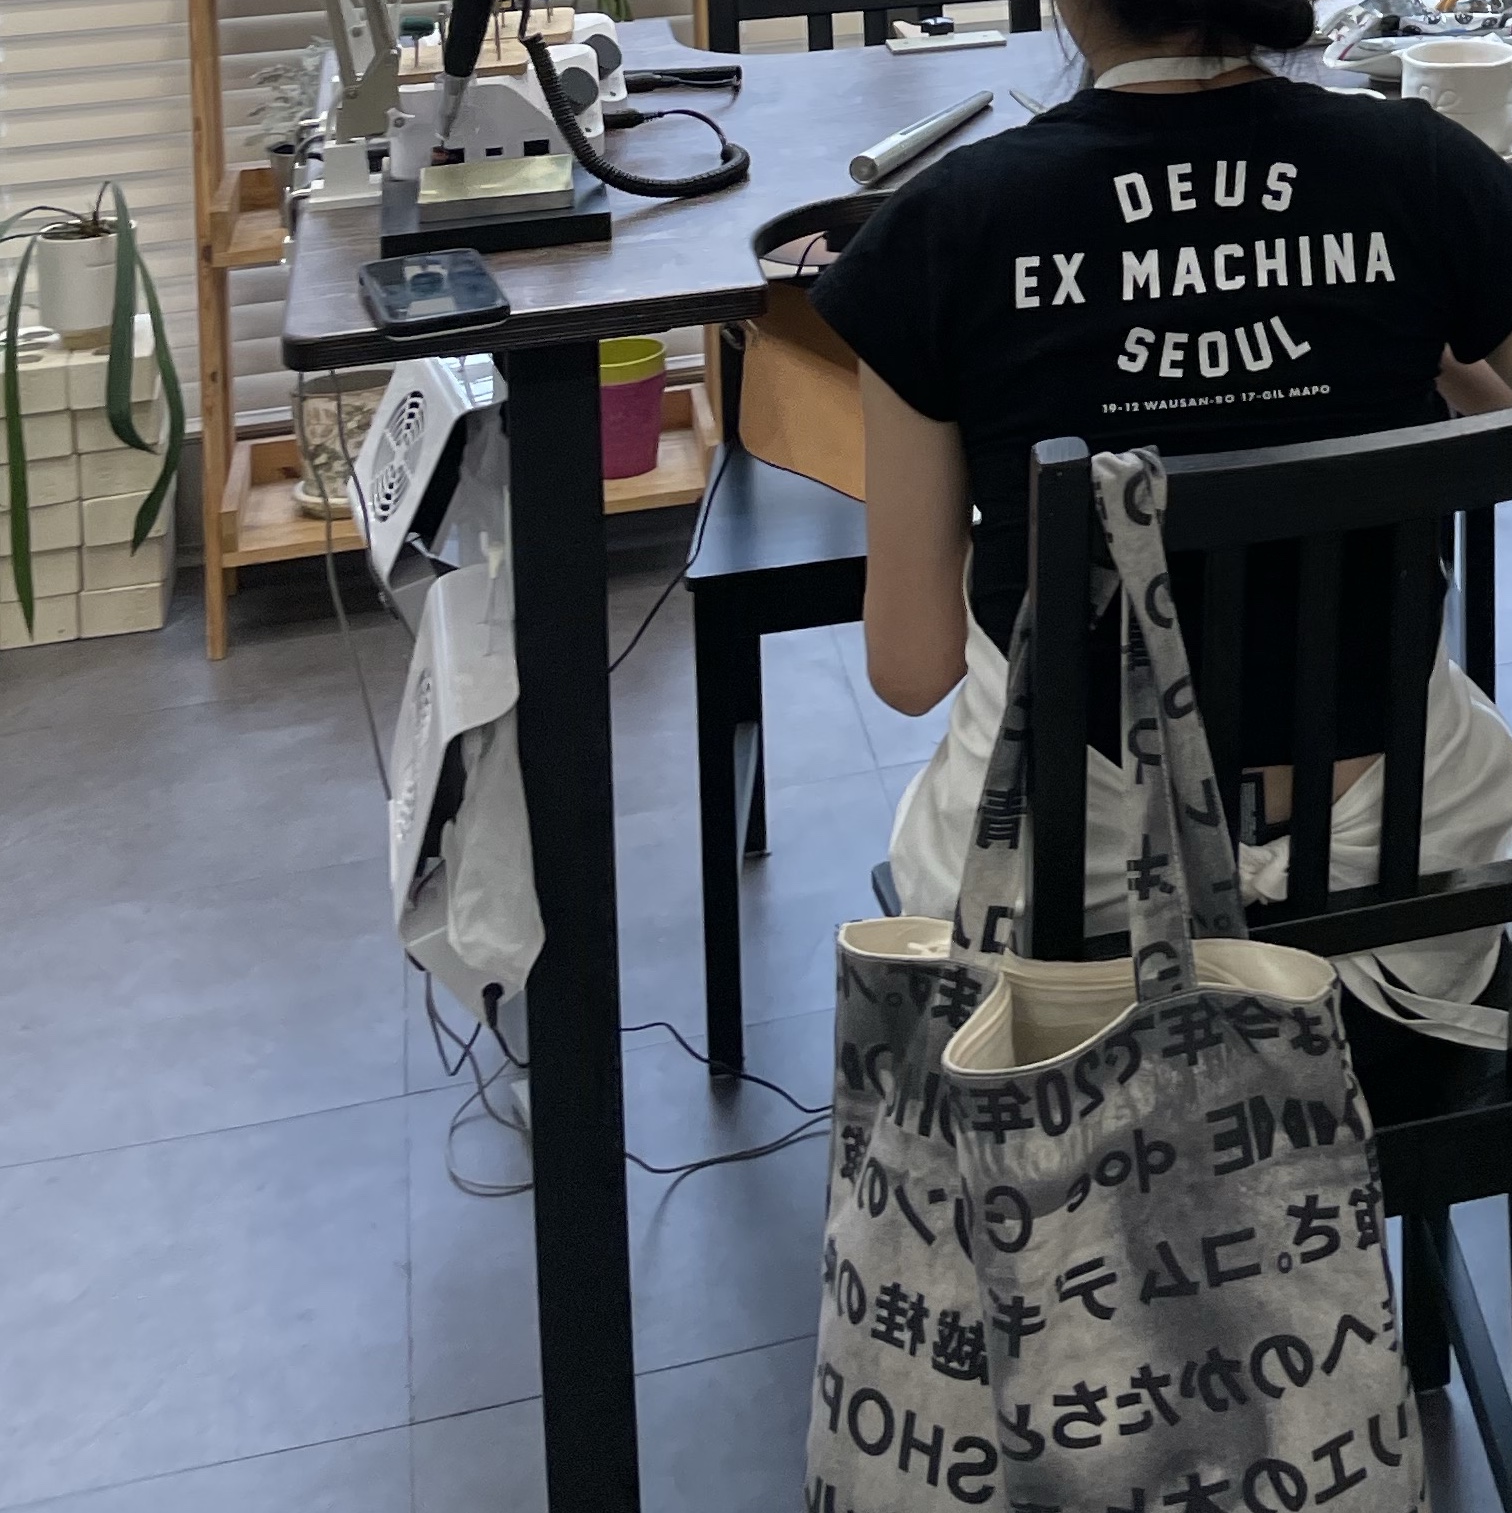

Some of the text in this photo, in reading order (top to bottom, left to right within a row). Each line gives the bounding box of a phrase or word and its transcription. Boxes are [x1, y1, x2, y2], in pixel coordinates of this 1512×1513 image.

[1114, 160, 1298, 223] DEUS
[1015, 232, 1396, 309] EX MACHINA
[1117, 316, 1312, 378] SEOUL
[1102, 403, 1140, 413] 19-12
[1241, 389, 1285, 402] 17-GIL
[1289, 384, 1331, 397] MAPO
